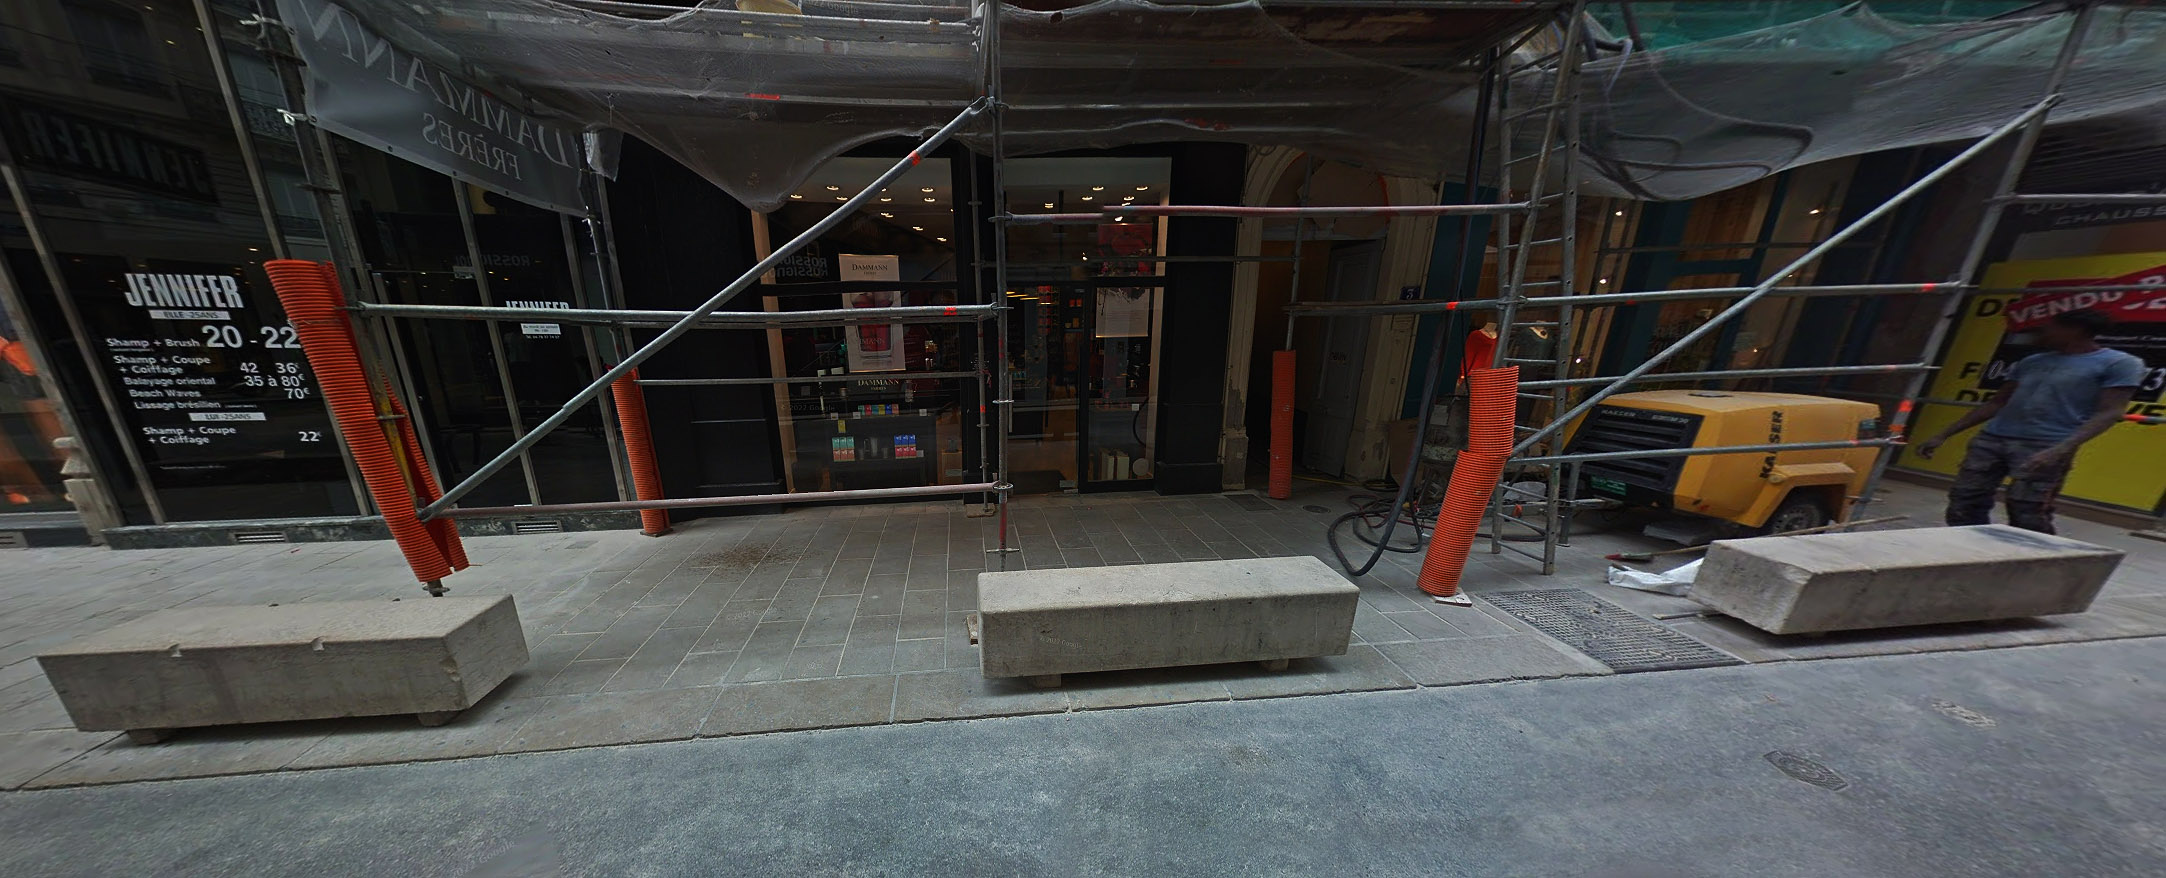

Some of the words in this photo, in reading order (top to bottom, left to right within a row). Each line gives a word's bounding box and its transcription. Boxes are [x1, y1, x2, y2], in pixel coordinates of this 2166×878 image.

[852, 263, 888, 271] DAMMANN
[124, 273, 244, 308] JENNIFER
[2008, 291, 2123, 323] VENDU
[106, 338, 150, 348] Shamp
[165, 338, 201, 347] Brush
[202, 325, 243, 348] 20
[113, 355, 157, 365] Shamp
[172, 355, 211, 366] Coupe
[131, 365, 184, 375] Coiffage
[240, 362, 259, 373] 42
[123, 377, 174, 387] Balayage
[175, 377, 216, 386] oriental
[244, 375, 264, 387] 35
[267, 375, 278, 387] à
[128, 389, 164, 398] Beach
[164, 390, 202, 398] Waves
[142, 427, 184, 437] Shamp
[198, 426, 237, 436] Coupe
[159, 436, 211, 446] Coiffage
[1758, 410, 1784, 479] KASER
